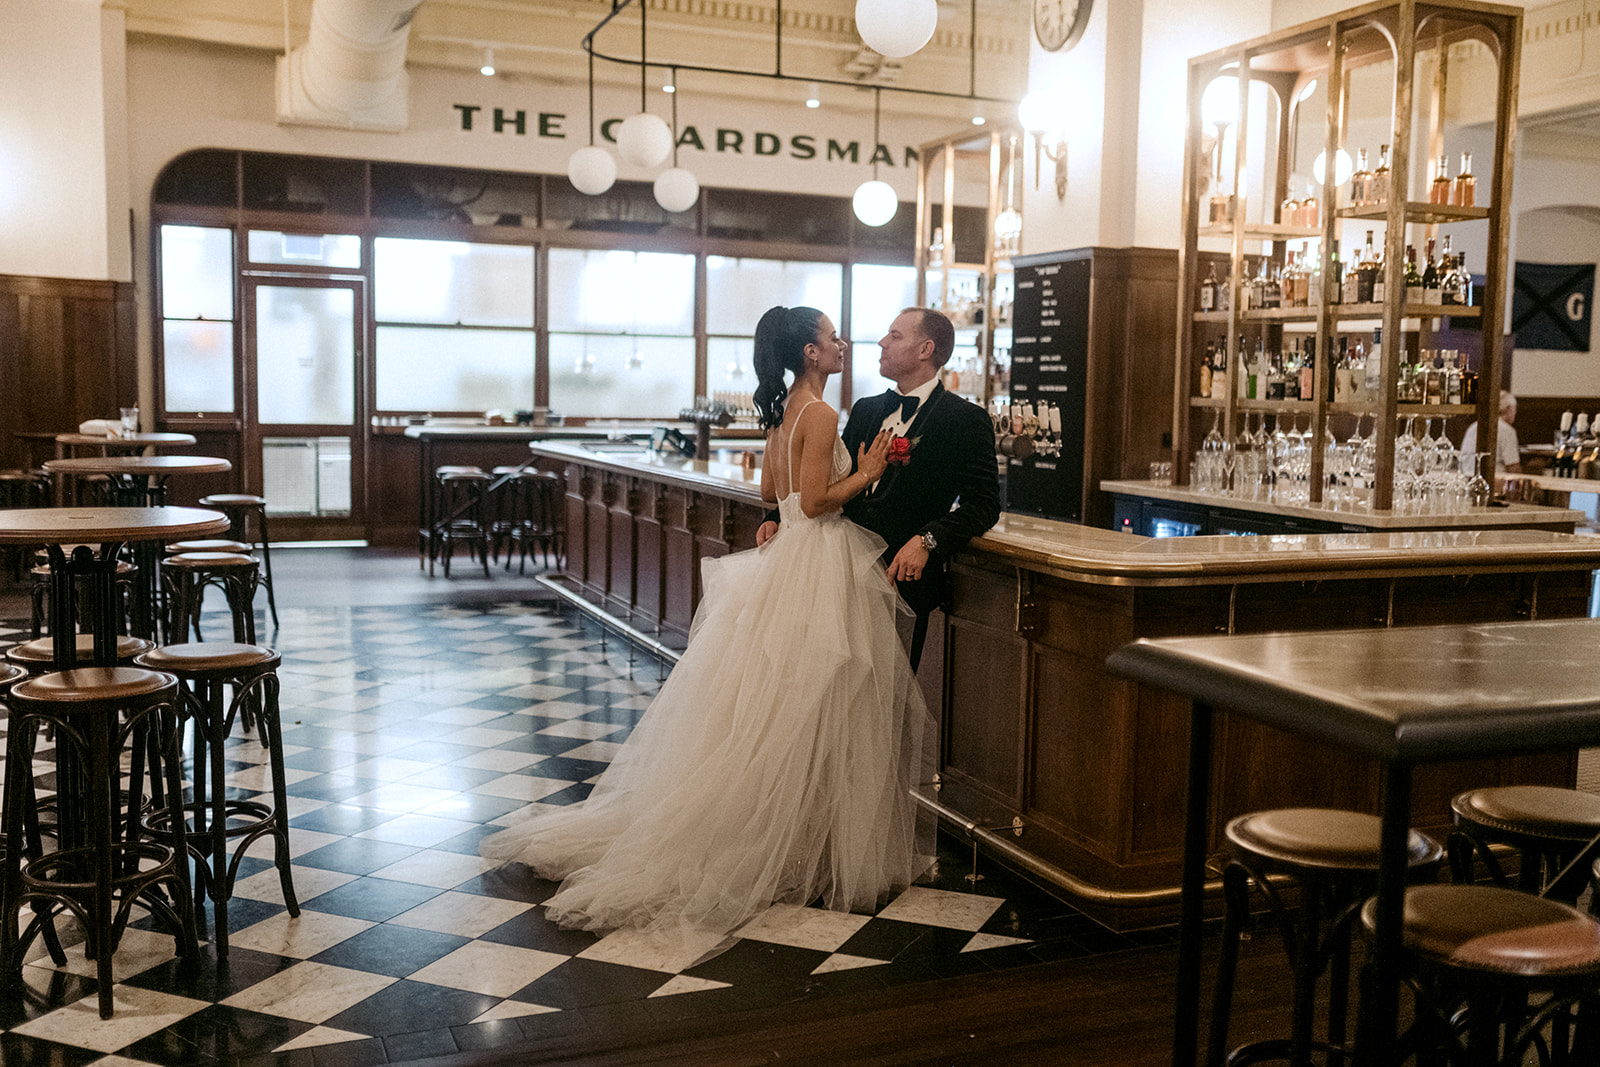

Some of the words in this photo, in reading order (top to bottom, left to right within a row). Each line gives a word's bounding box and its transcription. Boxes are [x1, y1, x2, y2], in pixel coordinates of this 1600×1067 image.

[453, 104, 566, 138] THE
[600, 118, 921, 167] GARDSMAN
[1567, 293, 1584, 321] G
